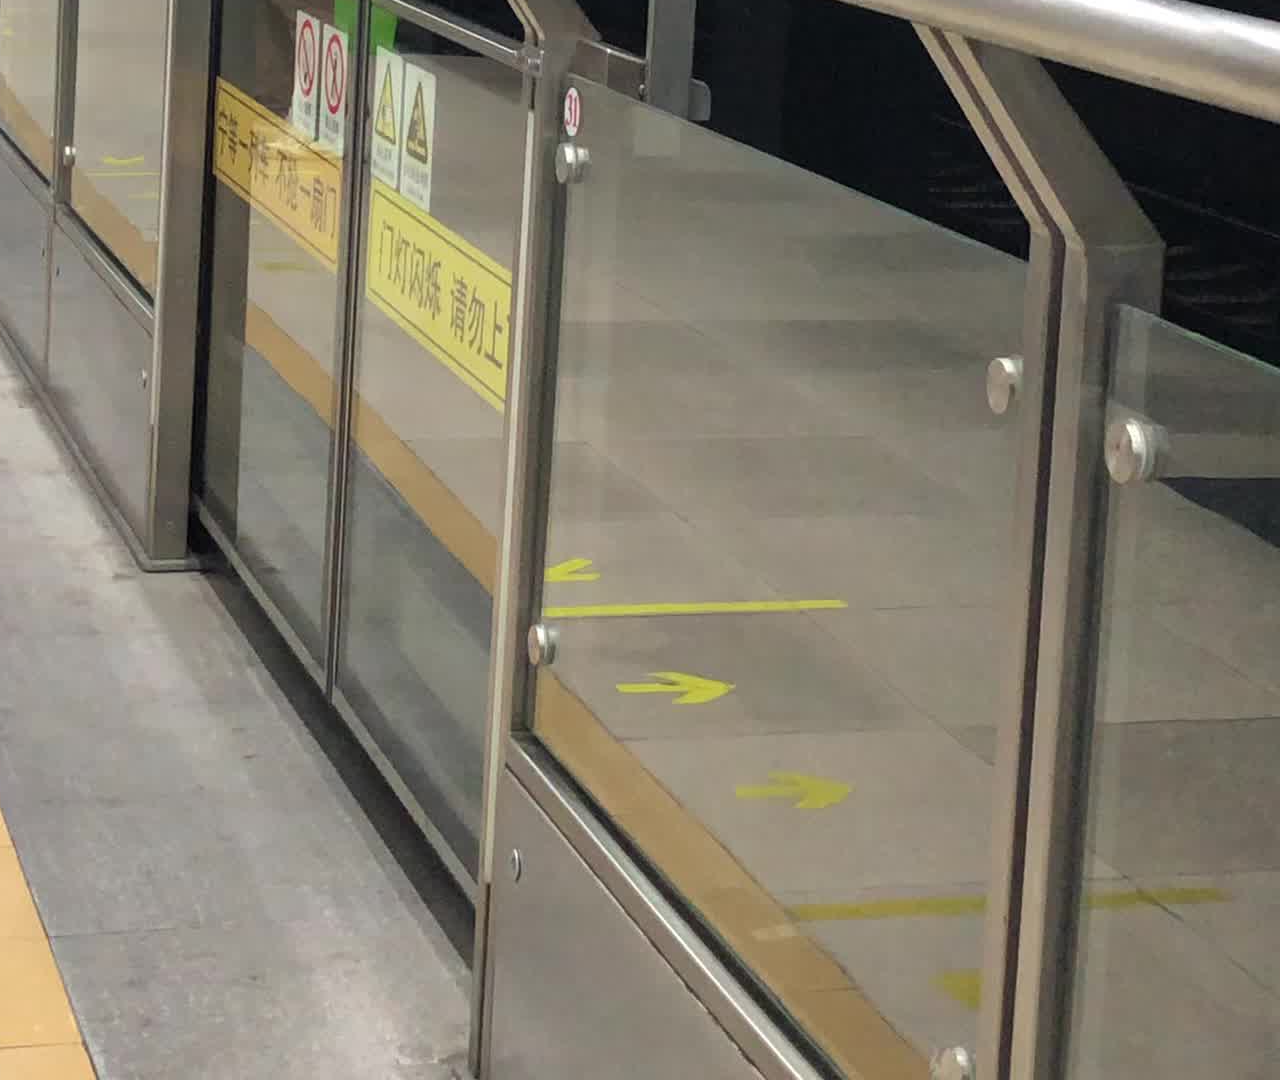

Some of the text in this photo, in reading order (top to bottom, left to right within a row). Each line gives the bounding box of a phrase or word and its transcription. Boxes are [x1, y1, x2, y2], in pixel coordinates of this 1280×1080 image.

[565, 93, 577, 128] 31
[378, 219, 511, 371] 门灯闪烁 请勿上
